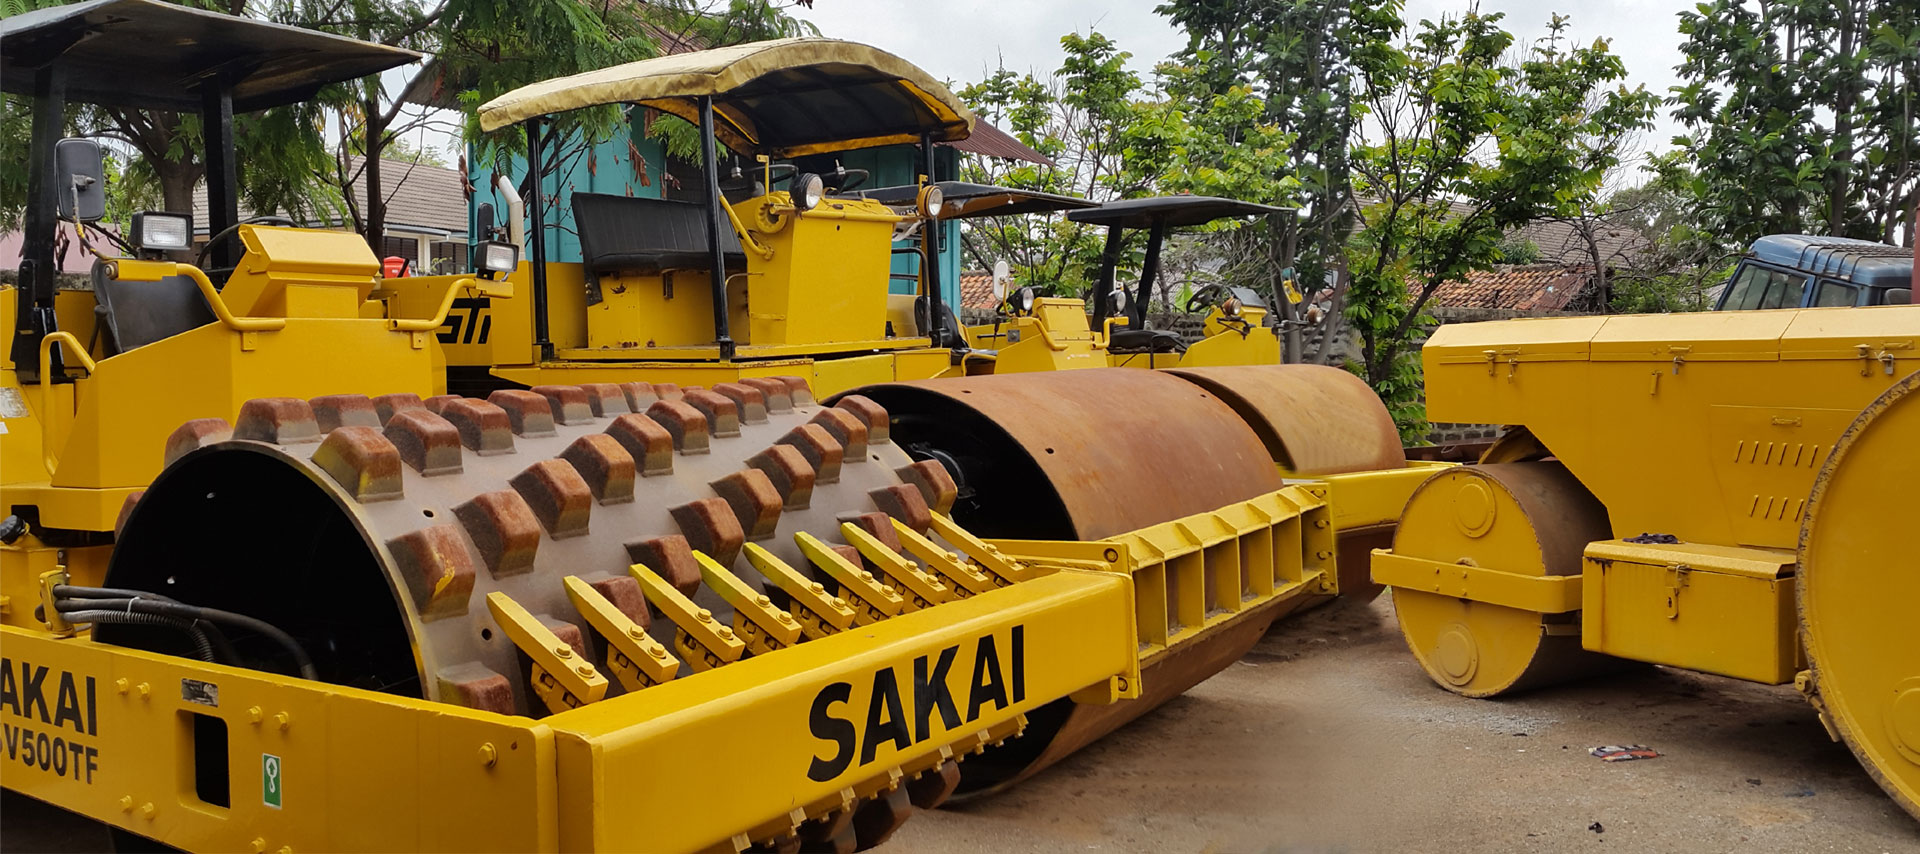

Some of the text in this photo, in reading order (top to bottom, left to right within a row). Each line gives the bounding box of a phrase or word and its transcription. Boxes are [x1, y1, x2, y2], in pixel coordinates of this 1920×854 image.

[0, 657, 97, 737] AKAI
[806, 624, 1025, 782] SAKAI
[0, 723, 98, 785] V500TF
